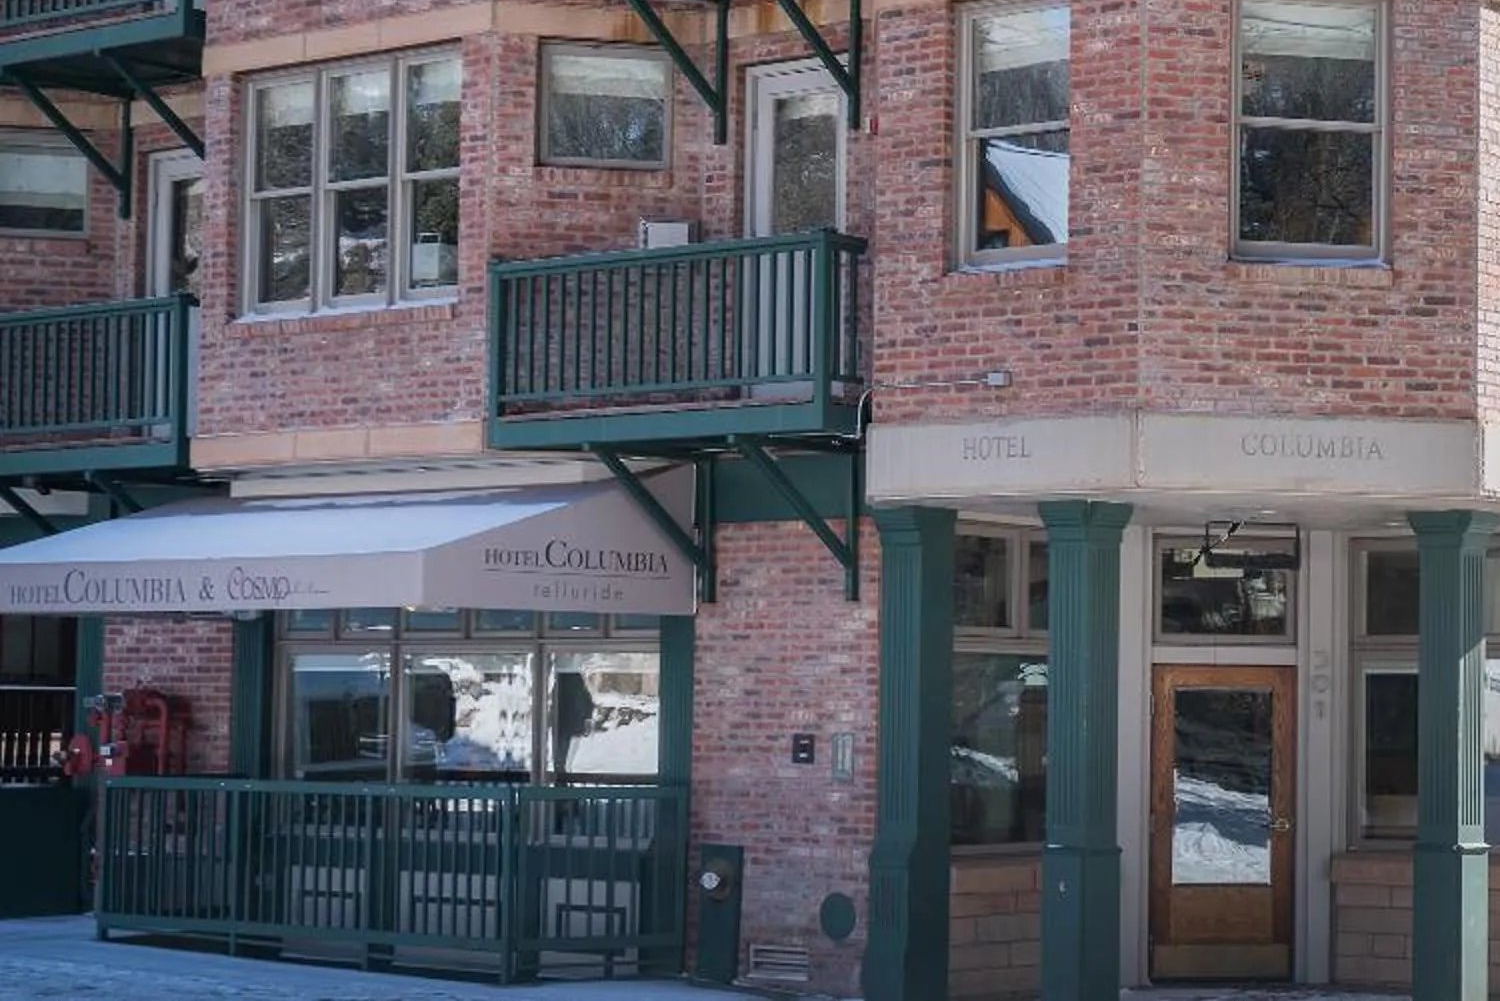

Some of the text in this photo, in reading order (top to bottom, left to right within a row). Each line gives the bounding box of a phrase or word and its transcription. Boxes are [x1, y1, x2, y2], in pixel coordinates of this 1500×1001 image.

[962, 434, 1385, 460] HOTEL COLUMBIA
[484, 538, 669, 574] HOTEL COLUMBIA
[10, 583, 64, 605] HOTEL
[63, 568, 187, 605] COLUMBIA
[199, 576, 215, 601] &
